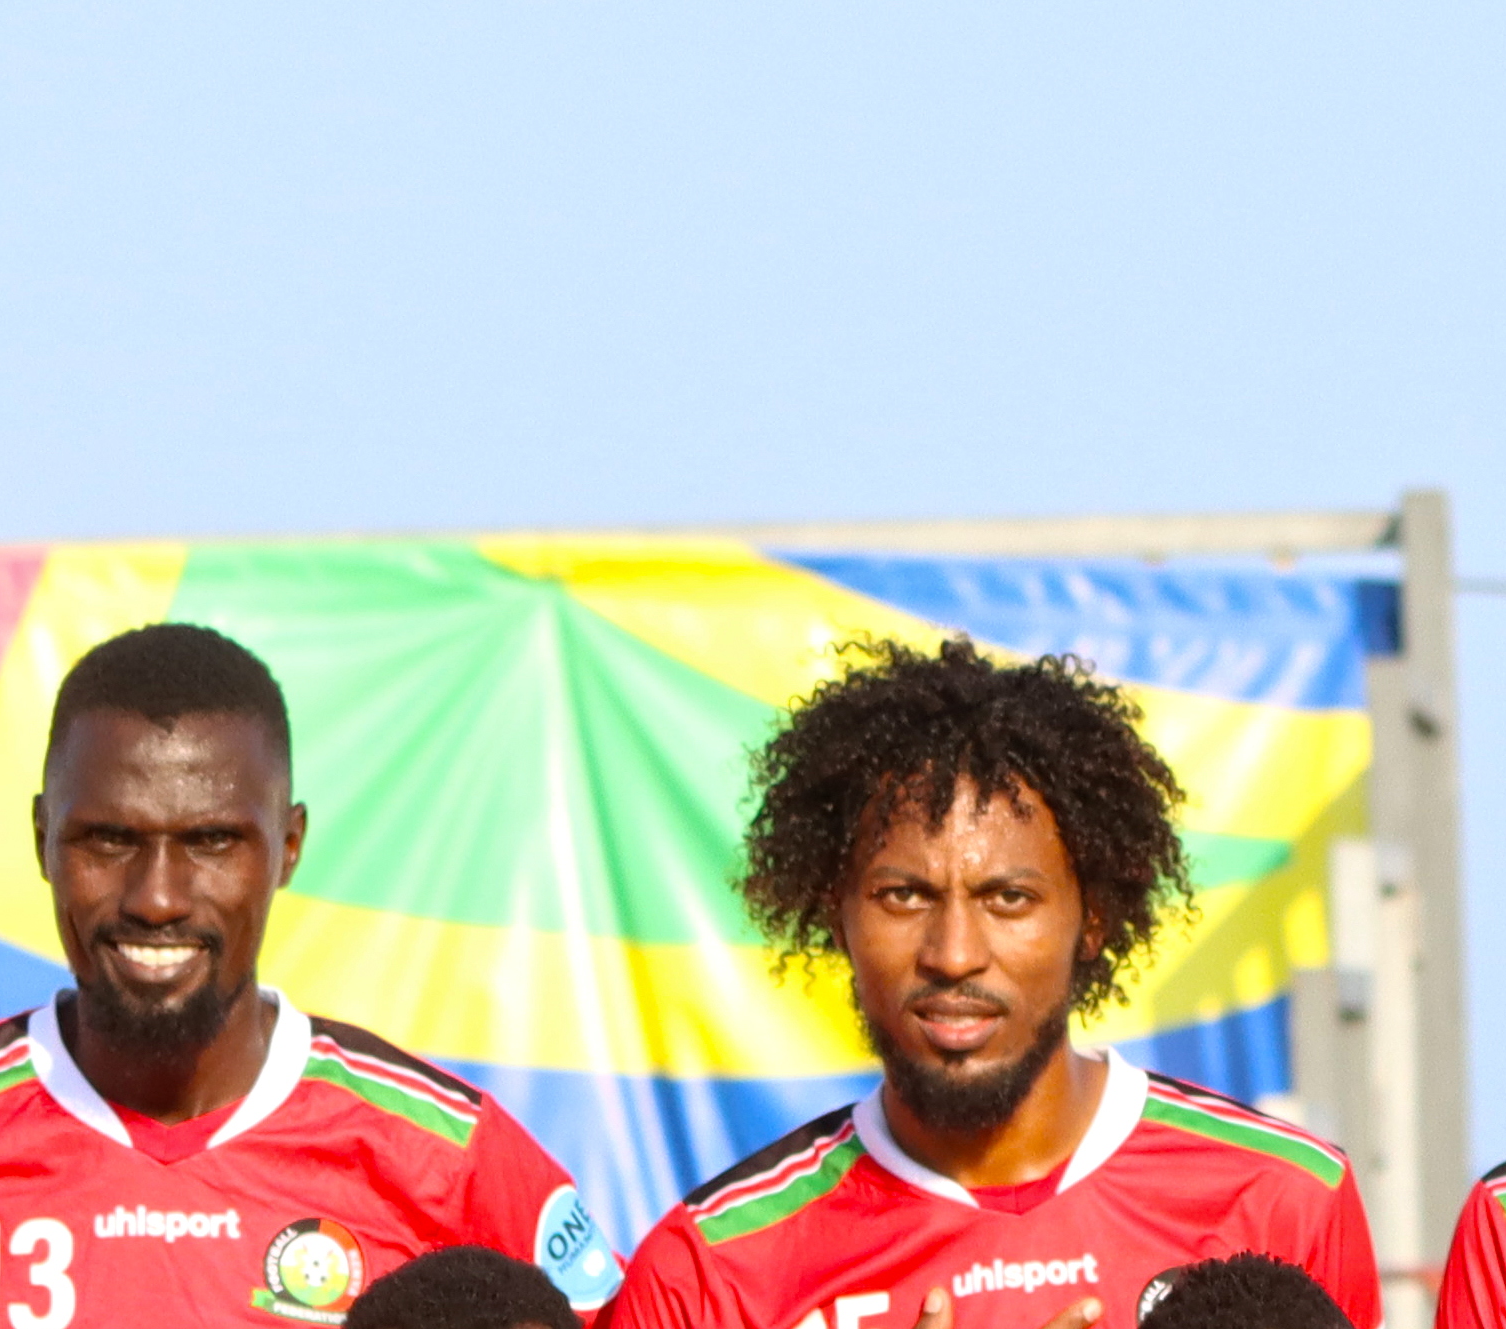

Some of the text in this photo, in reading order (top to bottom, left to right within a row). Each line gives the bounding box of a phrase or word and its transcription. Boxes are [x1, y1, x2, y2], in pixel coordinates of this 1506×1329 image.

[95, 1206, 241, 1242] uhlsport
[547, 1198, 590, 1261] ONE
[953, 1253, 1099, 1298] uhlsport
